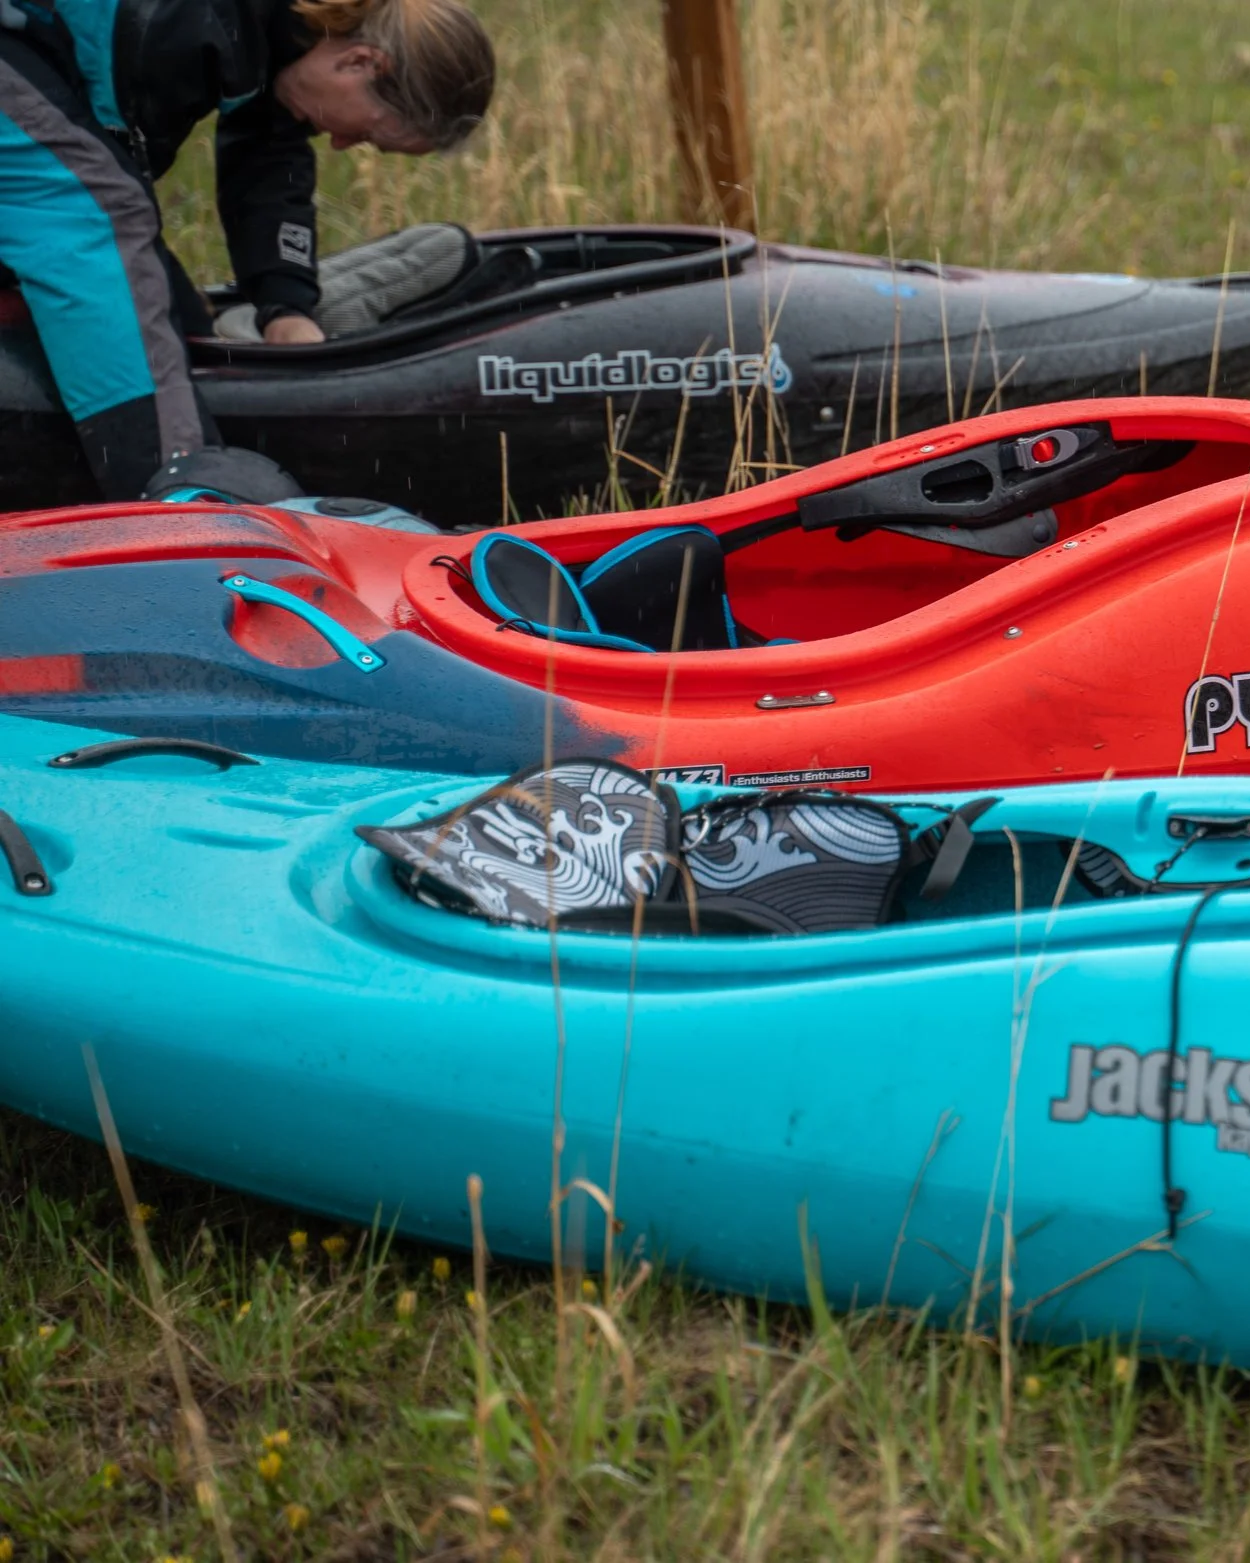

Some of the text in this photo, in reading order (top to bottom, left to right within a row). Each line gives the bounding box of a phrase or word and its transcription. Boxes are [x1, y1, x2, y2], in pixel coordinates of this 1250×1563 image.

[478, 348, 766, 402] liquidlogic
[737, 774, 799, 786] Enthusiasts
[805, 769, 867, 782] Enthusiasts
